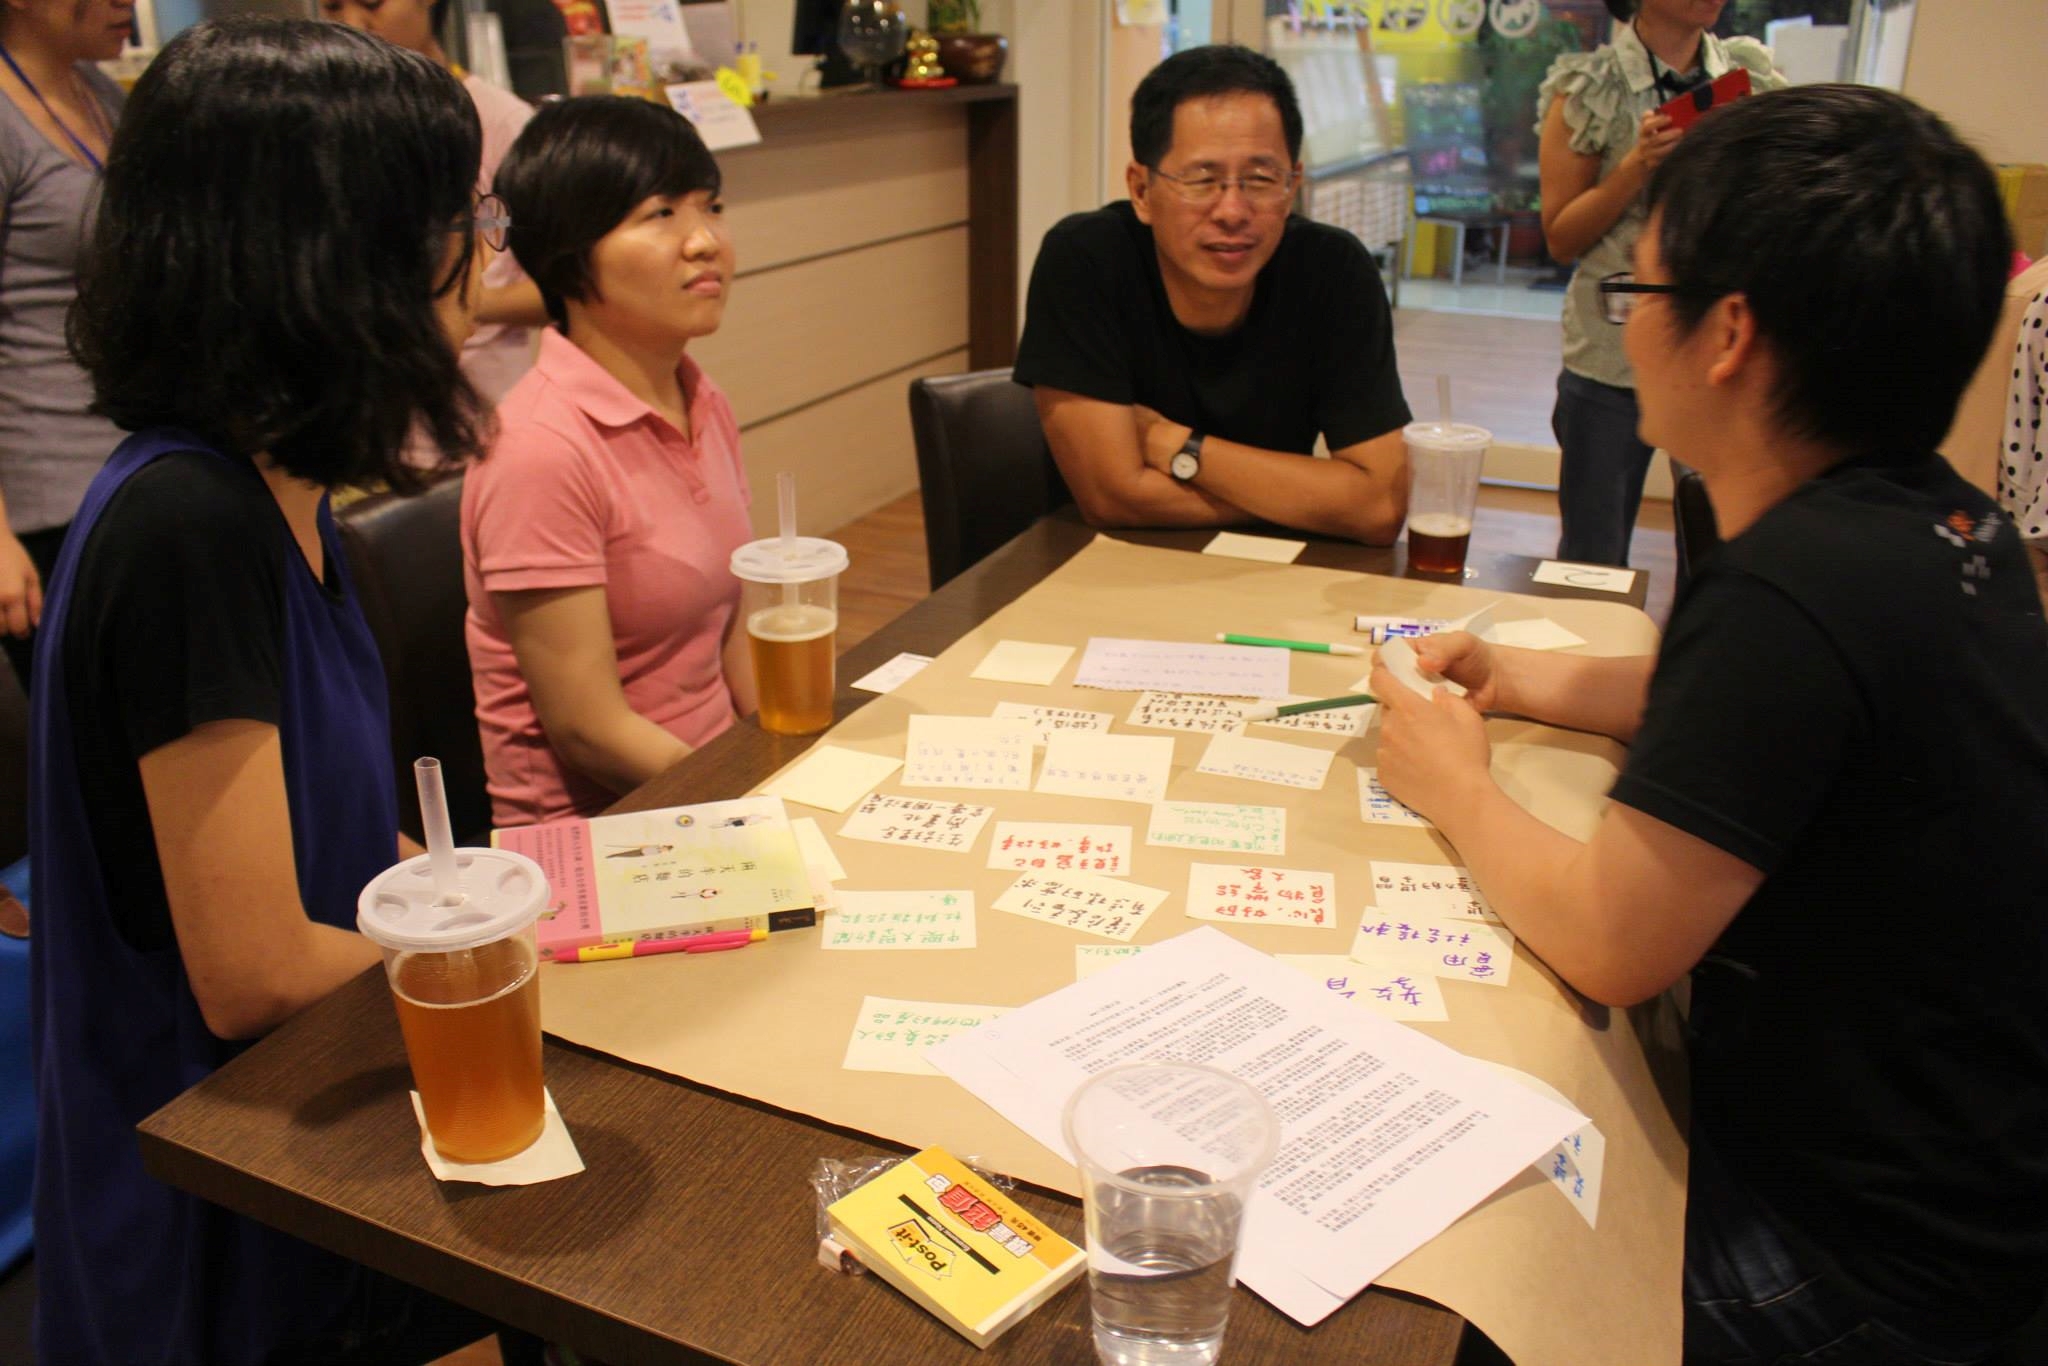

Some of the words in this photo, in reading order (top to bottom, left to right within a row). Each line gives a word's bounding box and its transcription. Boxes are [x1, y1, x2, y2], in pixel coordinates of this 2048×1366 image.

[1240, 868, 1285, 881] 大家
[1216, 882, 1325, 904] 食物帶給
[1361, 922, 1470, 946] 社會接軌
[1444, 952, 1495, 978] 實用
[1326, 976, 1422, 1006] 教育
[895, 1228, 946, 1271] Post-it
